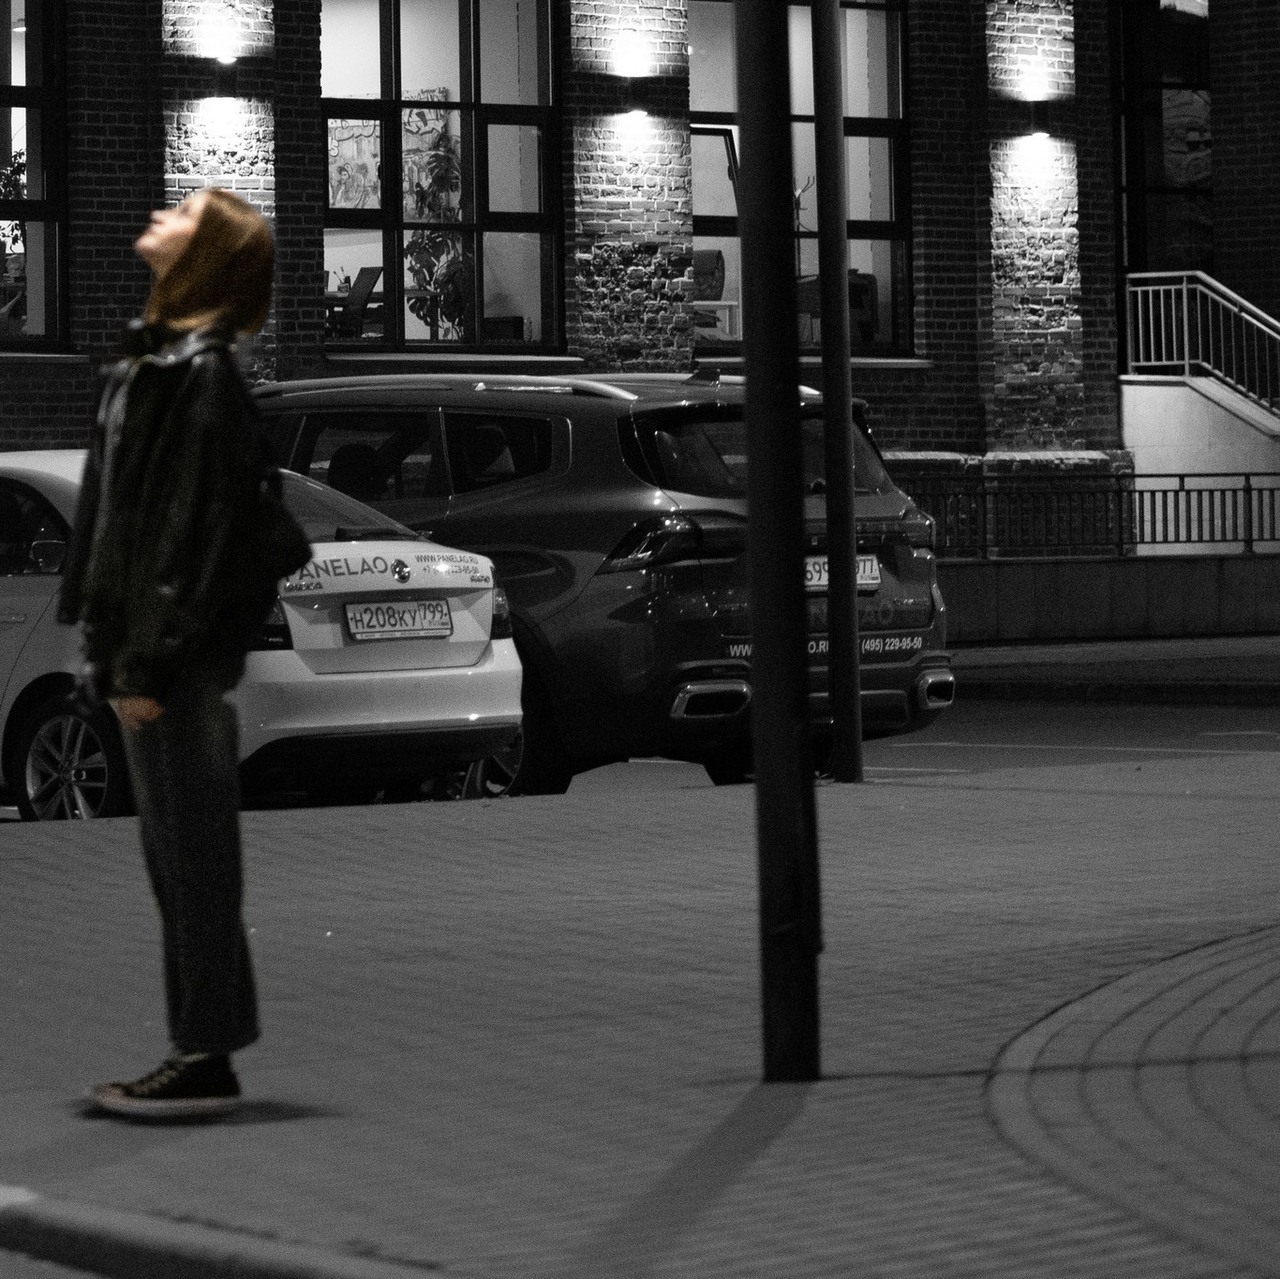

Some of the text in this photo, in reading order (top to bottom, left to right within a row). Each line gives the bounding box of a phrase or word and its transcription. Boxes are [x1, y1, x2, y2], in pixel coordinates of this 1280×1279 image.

[286, 556, 388, 582] ANELAO
[419, 603, 444, 620] 799
[861, 636, 923, 653] (495) 229-95-50
